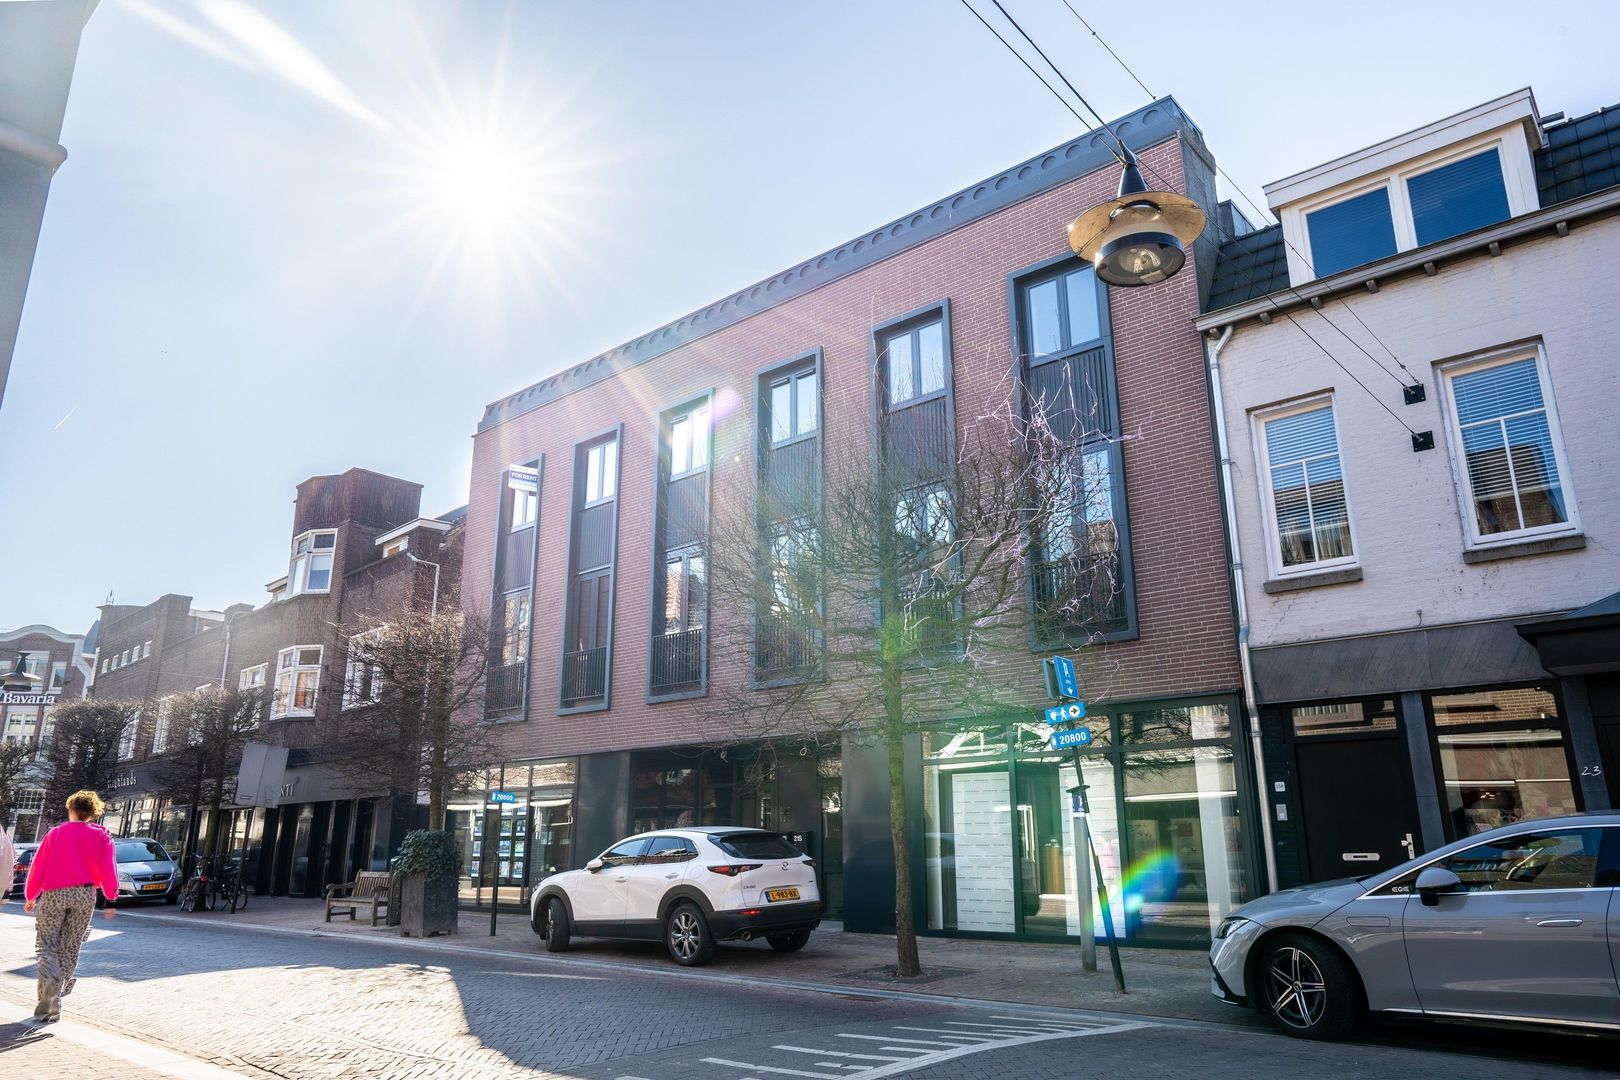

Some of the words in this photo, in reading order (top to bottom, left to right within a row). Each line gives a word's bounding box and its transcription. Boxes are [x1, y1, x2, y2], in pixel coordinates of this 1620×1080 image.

[522, 474, 537, 482] RENT
[3, 692, 55, 704] Bavaria
[1059, 731, 1087, 745] 20800
[1581, 765, 1602, 777] 23
